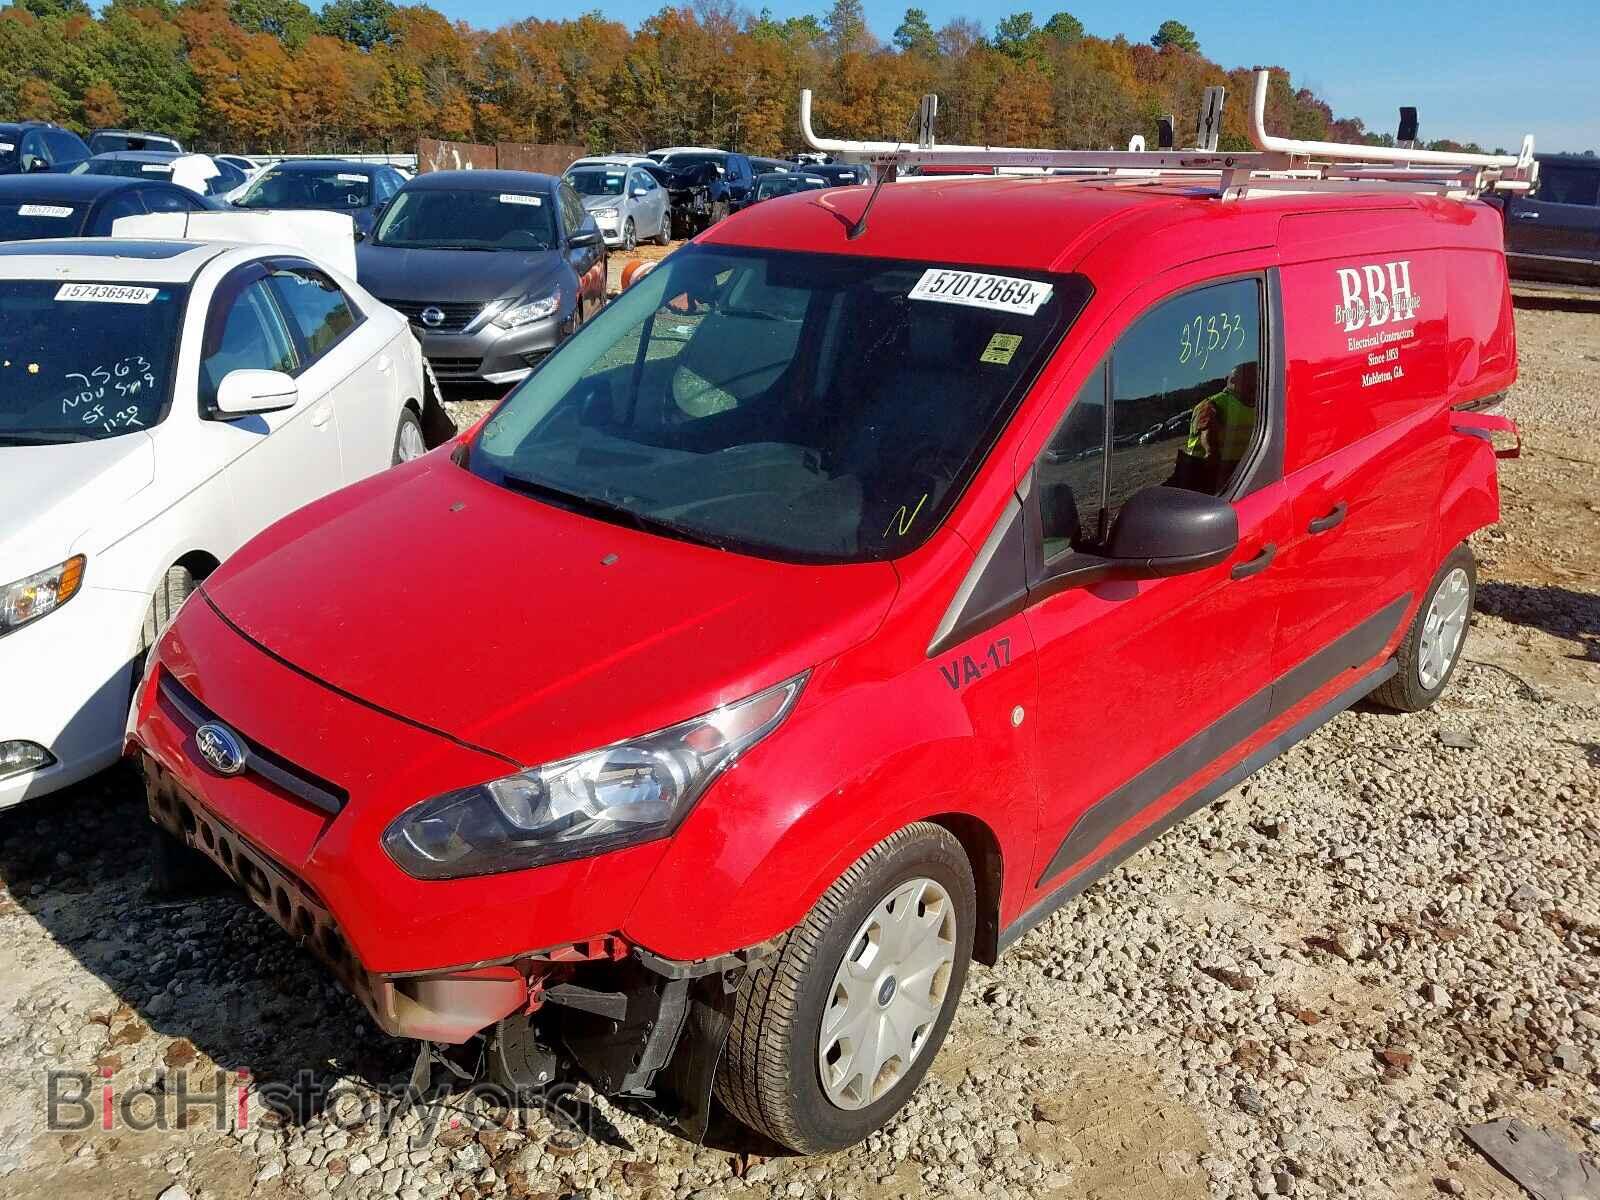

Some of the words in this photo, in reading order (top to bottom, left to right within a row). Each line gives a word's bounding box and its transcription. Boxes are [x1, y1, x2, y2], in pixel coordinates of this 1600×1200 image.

[1336, 260, 1415, 332] BBH
[1348, 332, 1379, 351] Electrical
[1380, 328, 1414, 344] Contractors
[1368, 353, 1385, 366] Since
[939, 637, 1012, 690] VA-17
